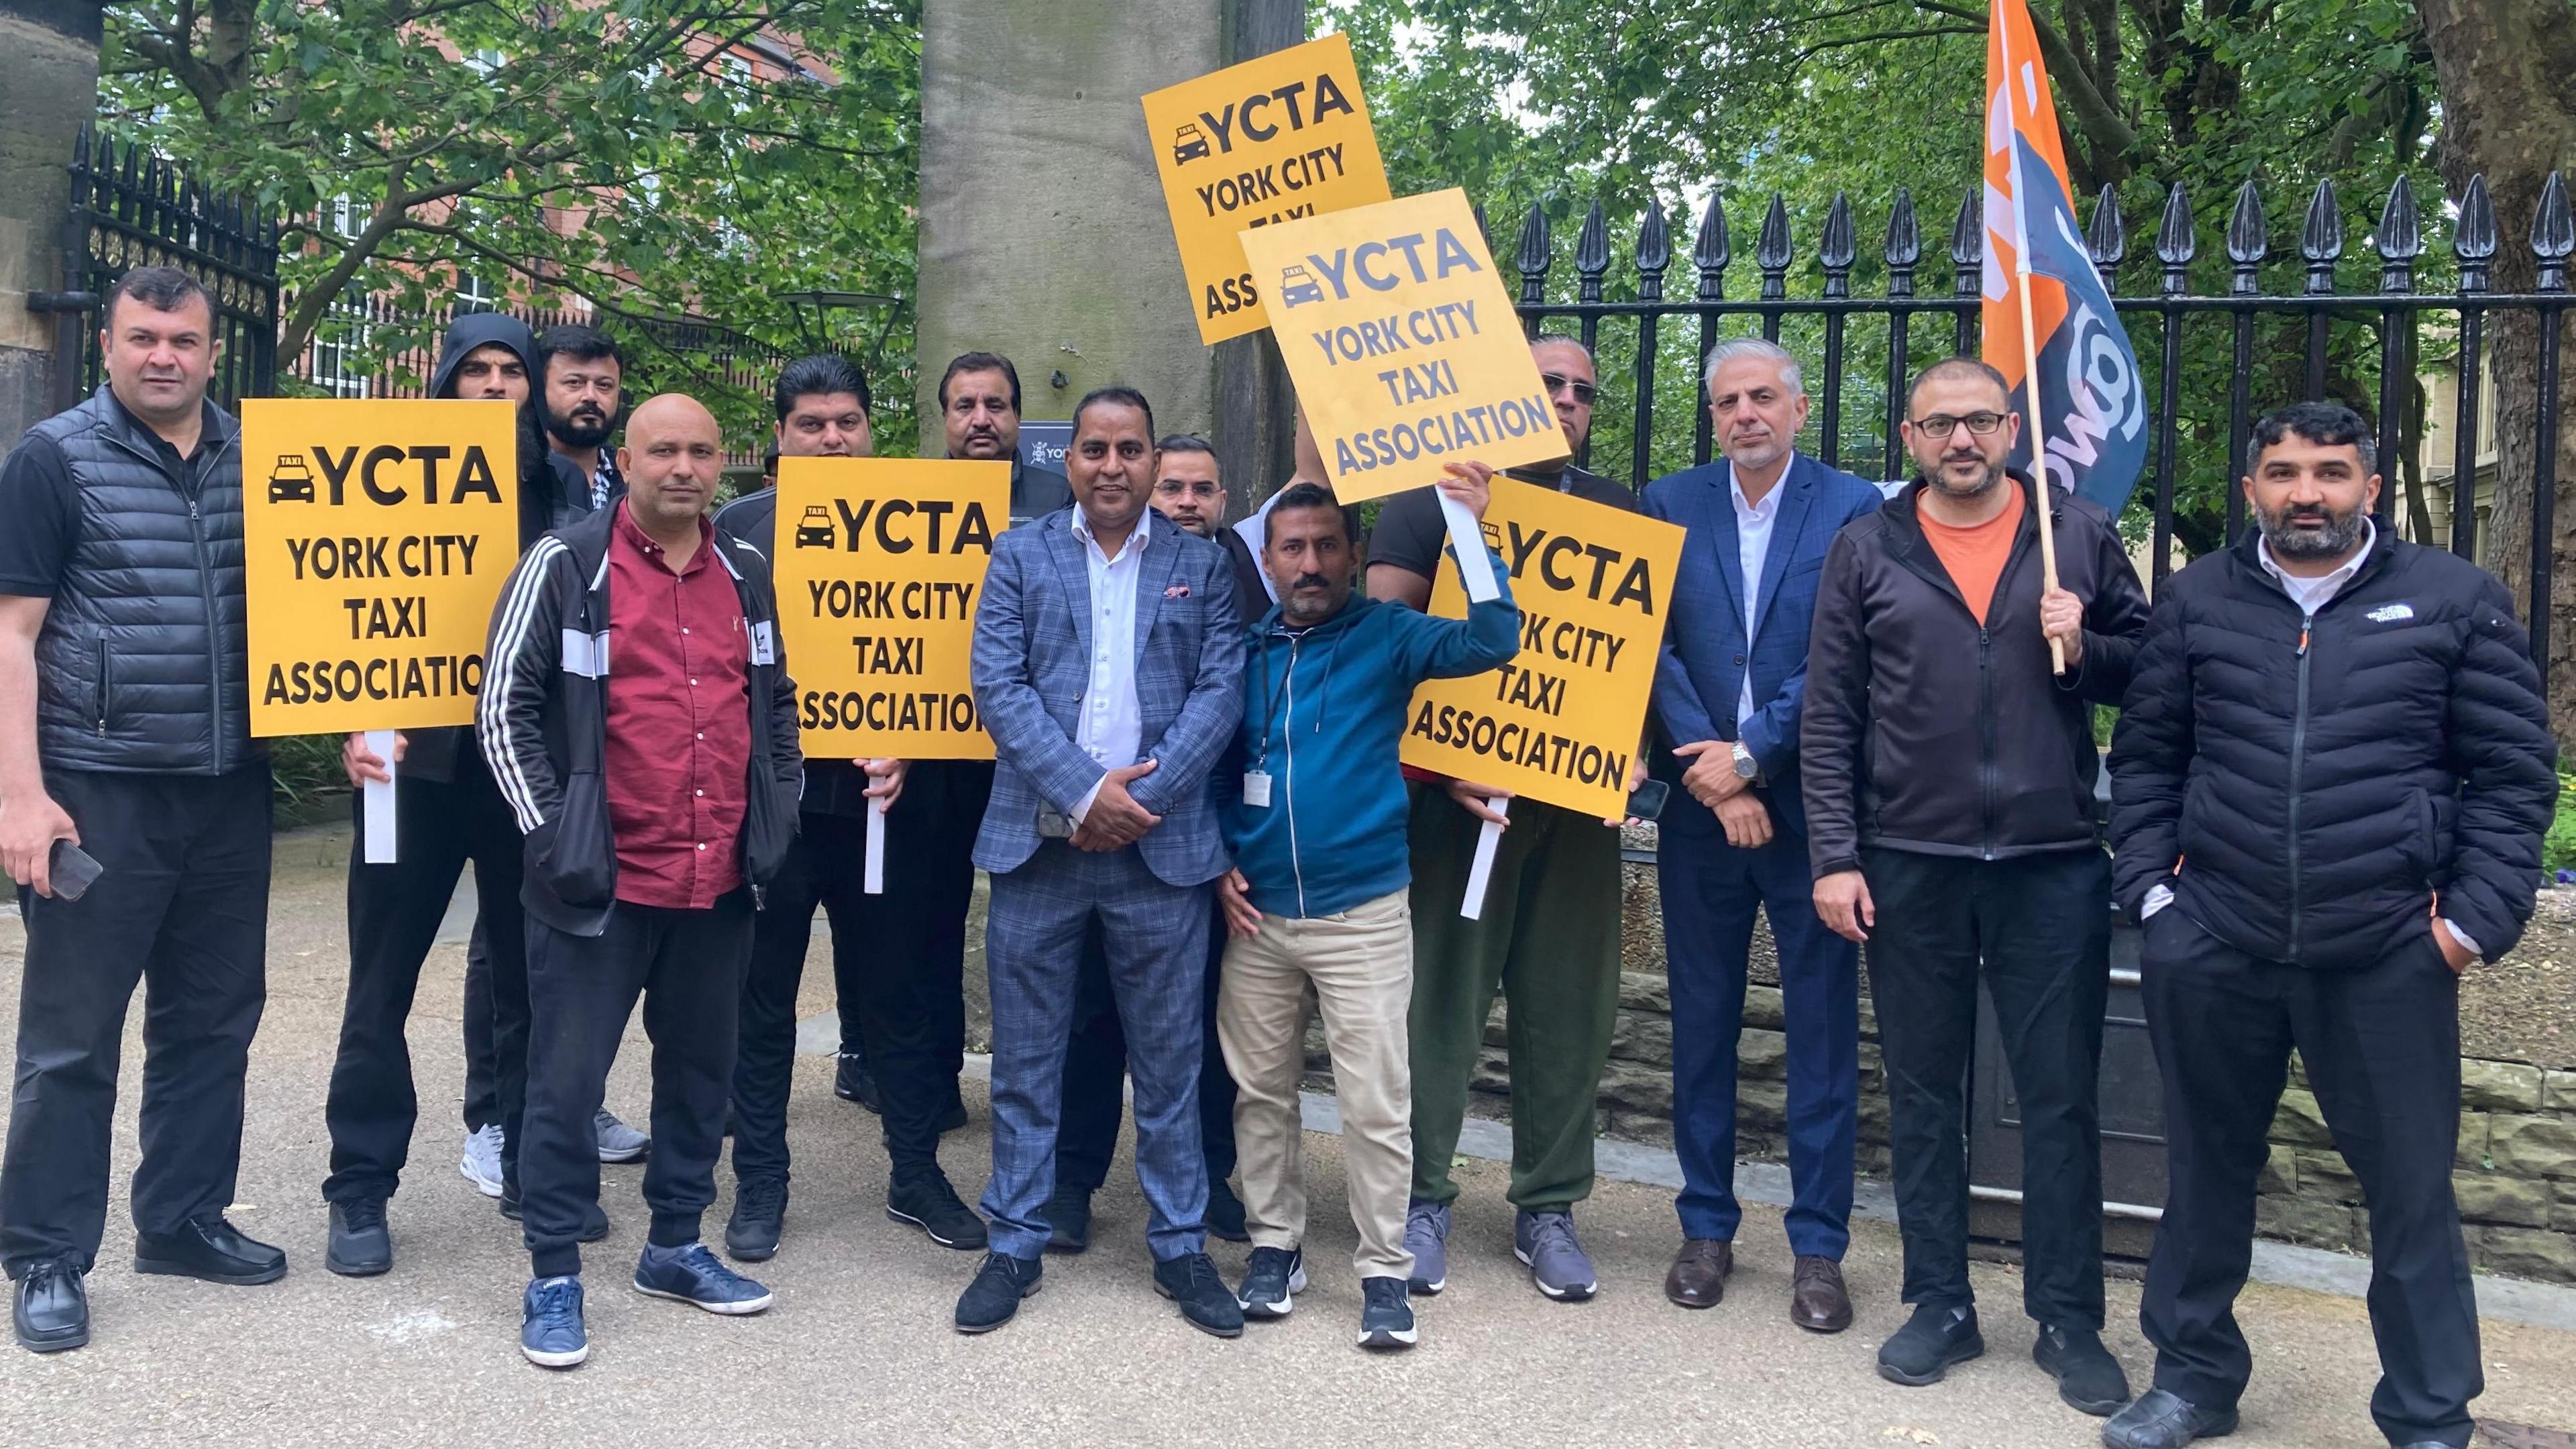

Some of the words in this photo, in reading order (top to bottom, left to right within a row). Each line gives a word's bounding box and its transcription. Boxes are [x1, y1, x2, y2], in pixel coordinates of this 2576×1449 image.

[1179, 125, 1194, 135] TAXI
[1199, 74, 1354, 153] YCTA
[1196, 167, 1280, 216] YORK
[1282, 143, 1344, 190] CITY
[1284, 266, 1302, 276] TAXI
[1307, 229, 1481, 299] YCTA
[1313, 320, 1409, 366] YORK
[1409, 301, 1478, 345] CITY
[1378, 360, 1458, 405] TAXI
[1334, 393, 1554, 476] ASSOCIATION
[280, 456, 302, 466] TAXI
[311, 445, 502, 505] YCTA
[807, 507, 826, 516] TAXI
[833, 499, 991, 554] YCTA
[286, 537, 390, 579] YORK
[398, 535, 479, 577] CITY
[1508, 521, 1653, 616] YCTA
[344, 597, 426, 639] TAXI
[808, 580, 895, 619] YORK
[902, 582, 973, 620] CITY
[853, 637, 923, 674] TAXI
[1553, 623, 1625, 672] CITY
[264, 655, 483, 705] ASSOCIATIO
[1497, 663, 1566, 716] TAXI
[797, 691, 982, 732] SSOCIATIO
[1410, 700, 1627, 793] ASSOCIATION
